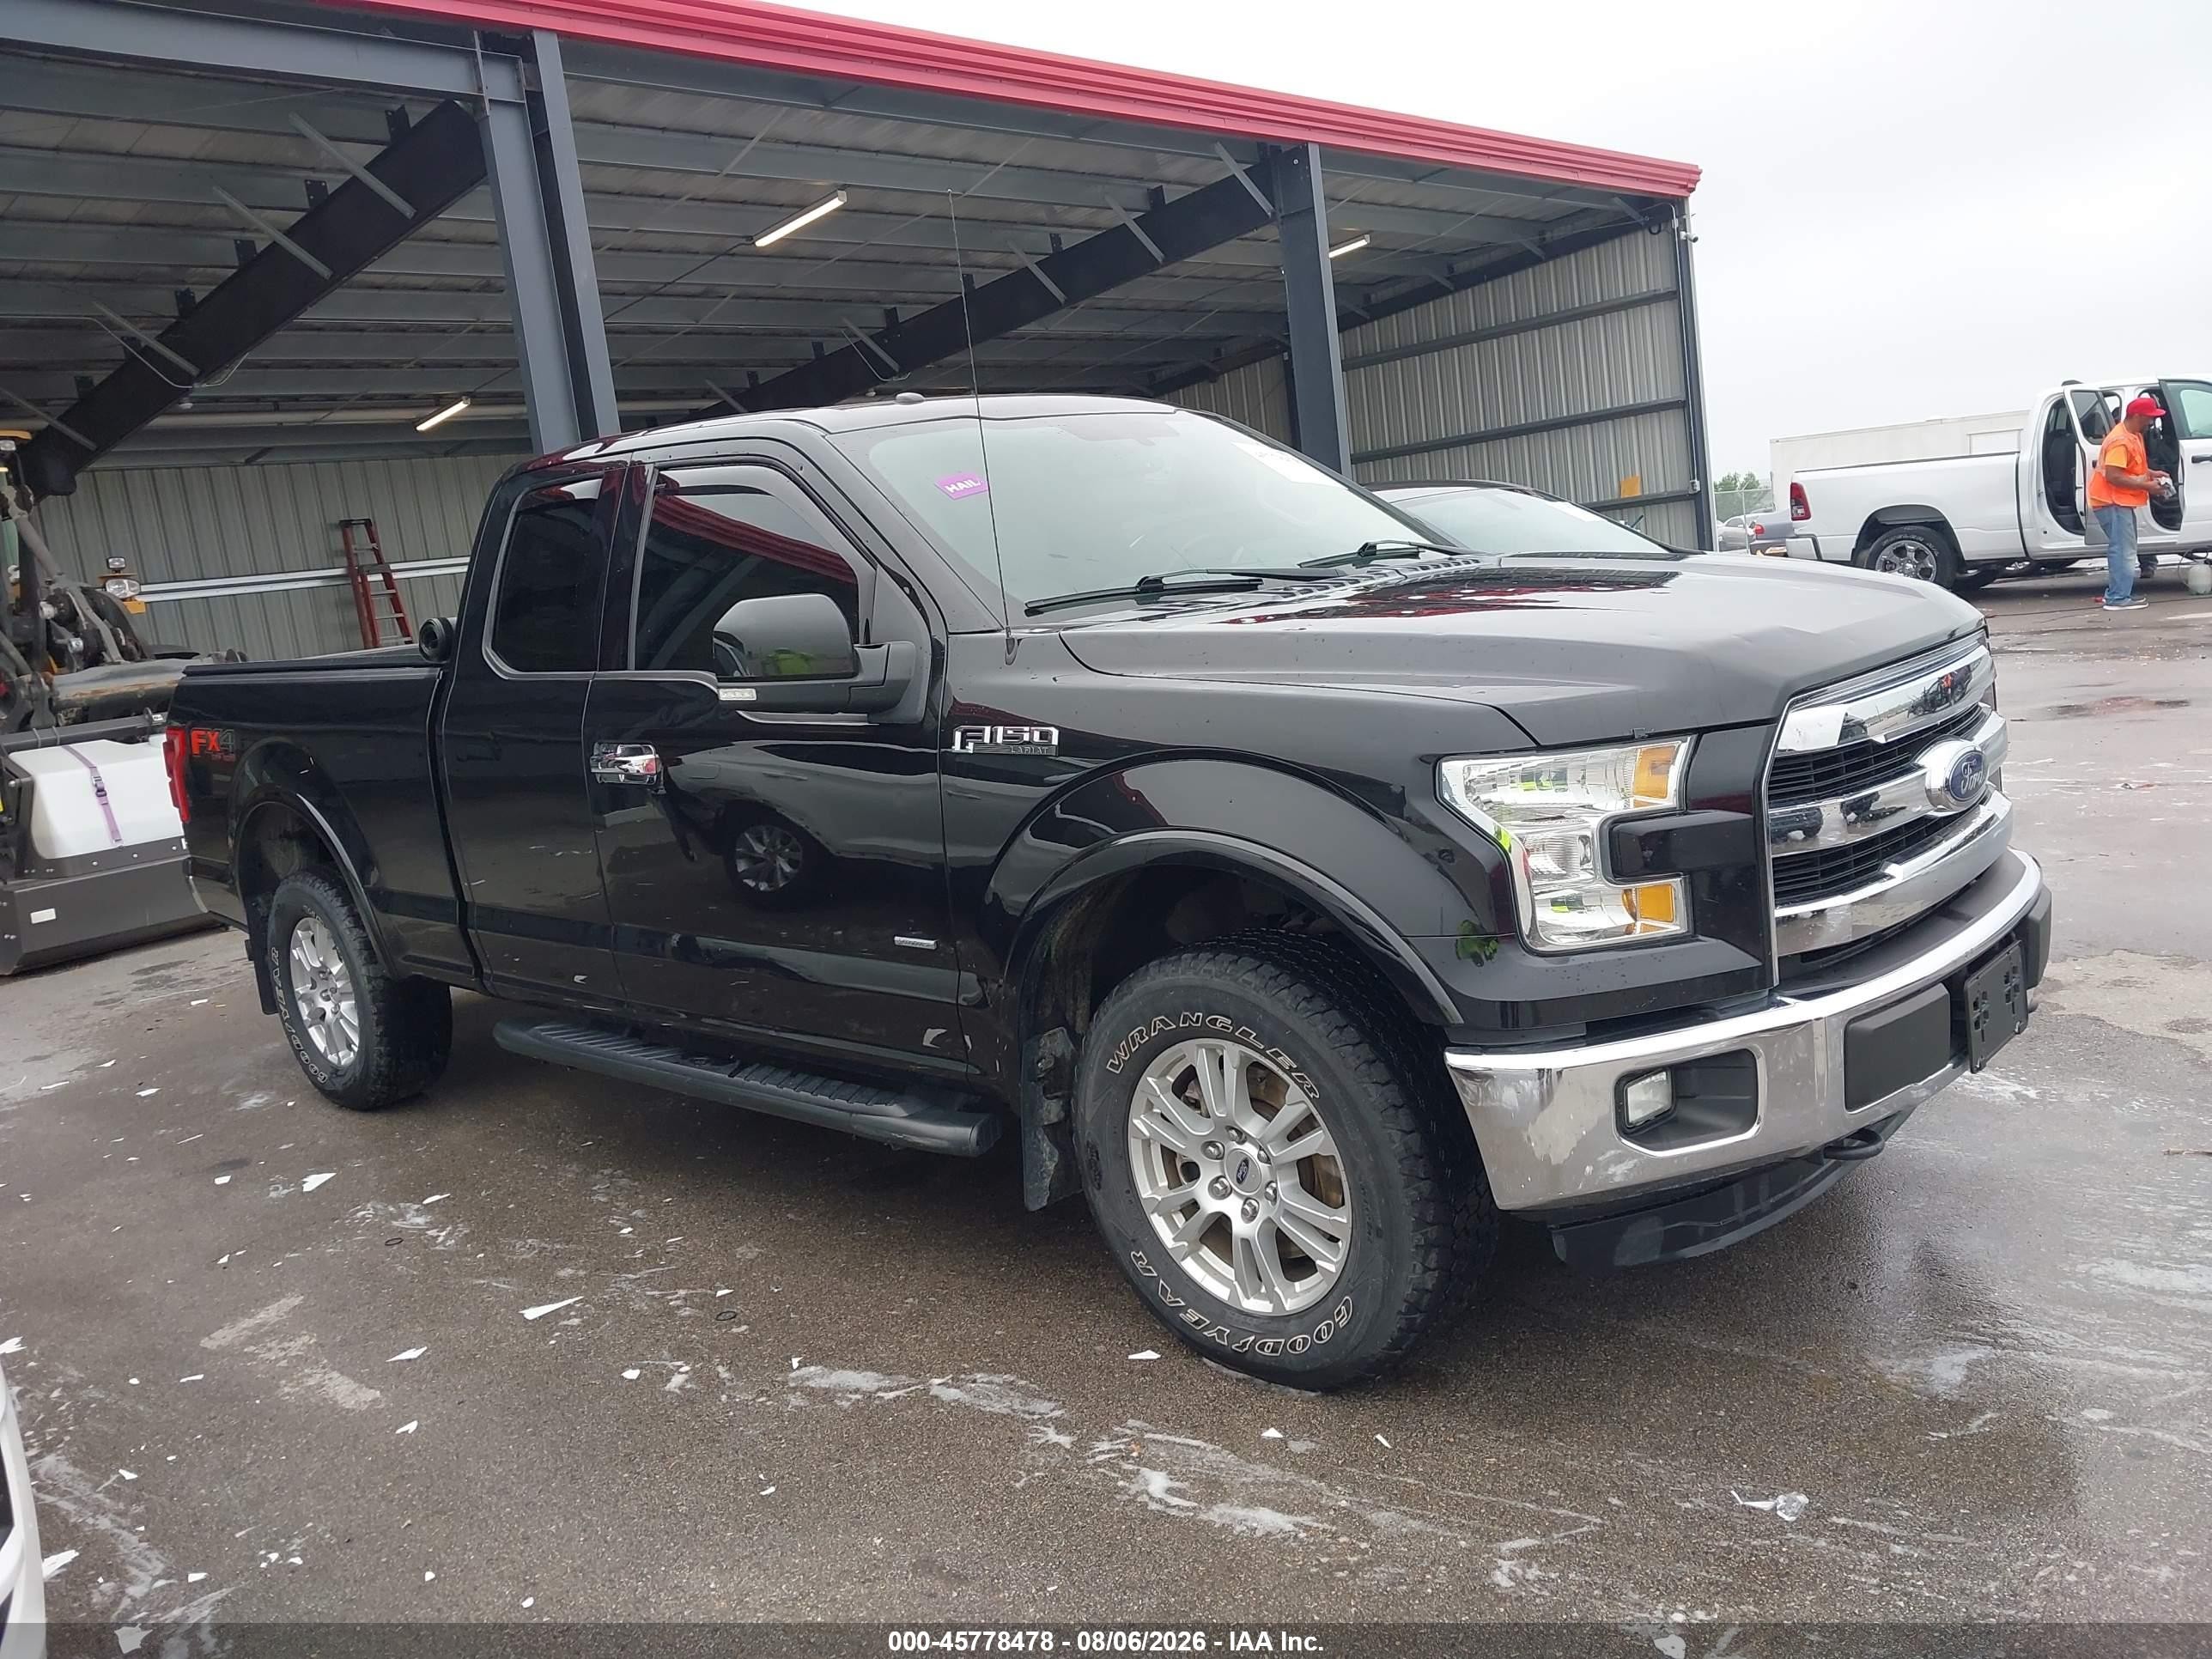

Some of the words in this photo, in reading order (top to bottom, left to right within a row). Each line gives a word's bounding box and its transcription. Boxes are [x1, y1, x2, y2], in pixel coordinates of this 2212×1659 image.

[945, 479, 981, 493] HAIL
[190, 727, 235, 757] FX4
[1960, 758, 1984, 794] Ford
[1106, 1012, 1321, 1100] WRANGLER
[1130, 1250, 1354, 1357] GOODYEAR
